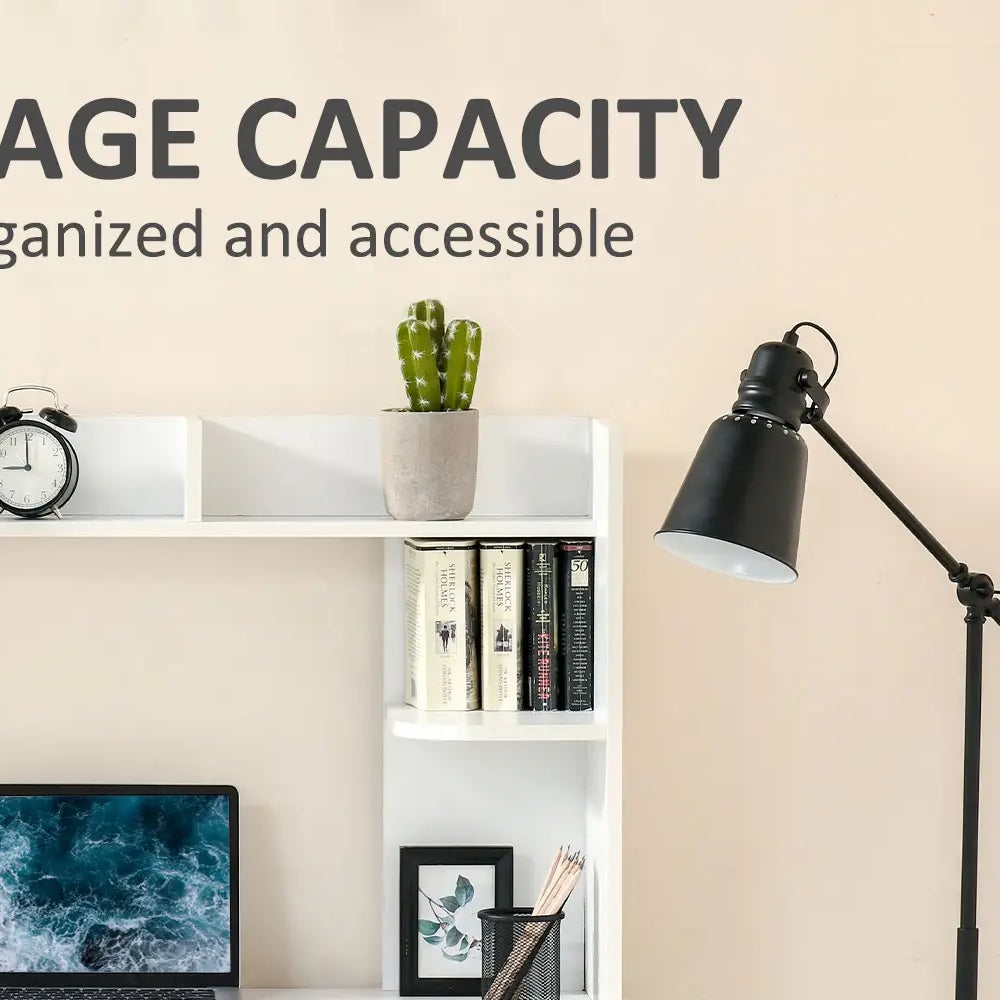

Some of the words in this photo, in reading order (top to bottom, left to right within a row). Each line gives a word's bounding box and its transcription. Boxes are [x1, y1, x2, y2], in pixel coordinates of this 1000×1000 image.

[10, 437, 17, 446] 11
[52, 448, 59, 456] 2
[57, 464, 63, 473] 3
[51, 479, 57, 488] 4
[9, 489, 15, 499] 7
[23, 494, 30, 504] 6
[41, 490, 47, 500] 5
[571, 560, 589, 573] 50
[440, 569, 448, 608] HOLMES
[448, 563, 456, 613] SHERLOCK
[504, 561, 512, 612] SHERLOCK
[537, 633, 551, 656] KITE
[537, 658, 551, 700] RUNNER
